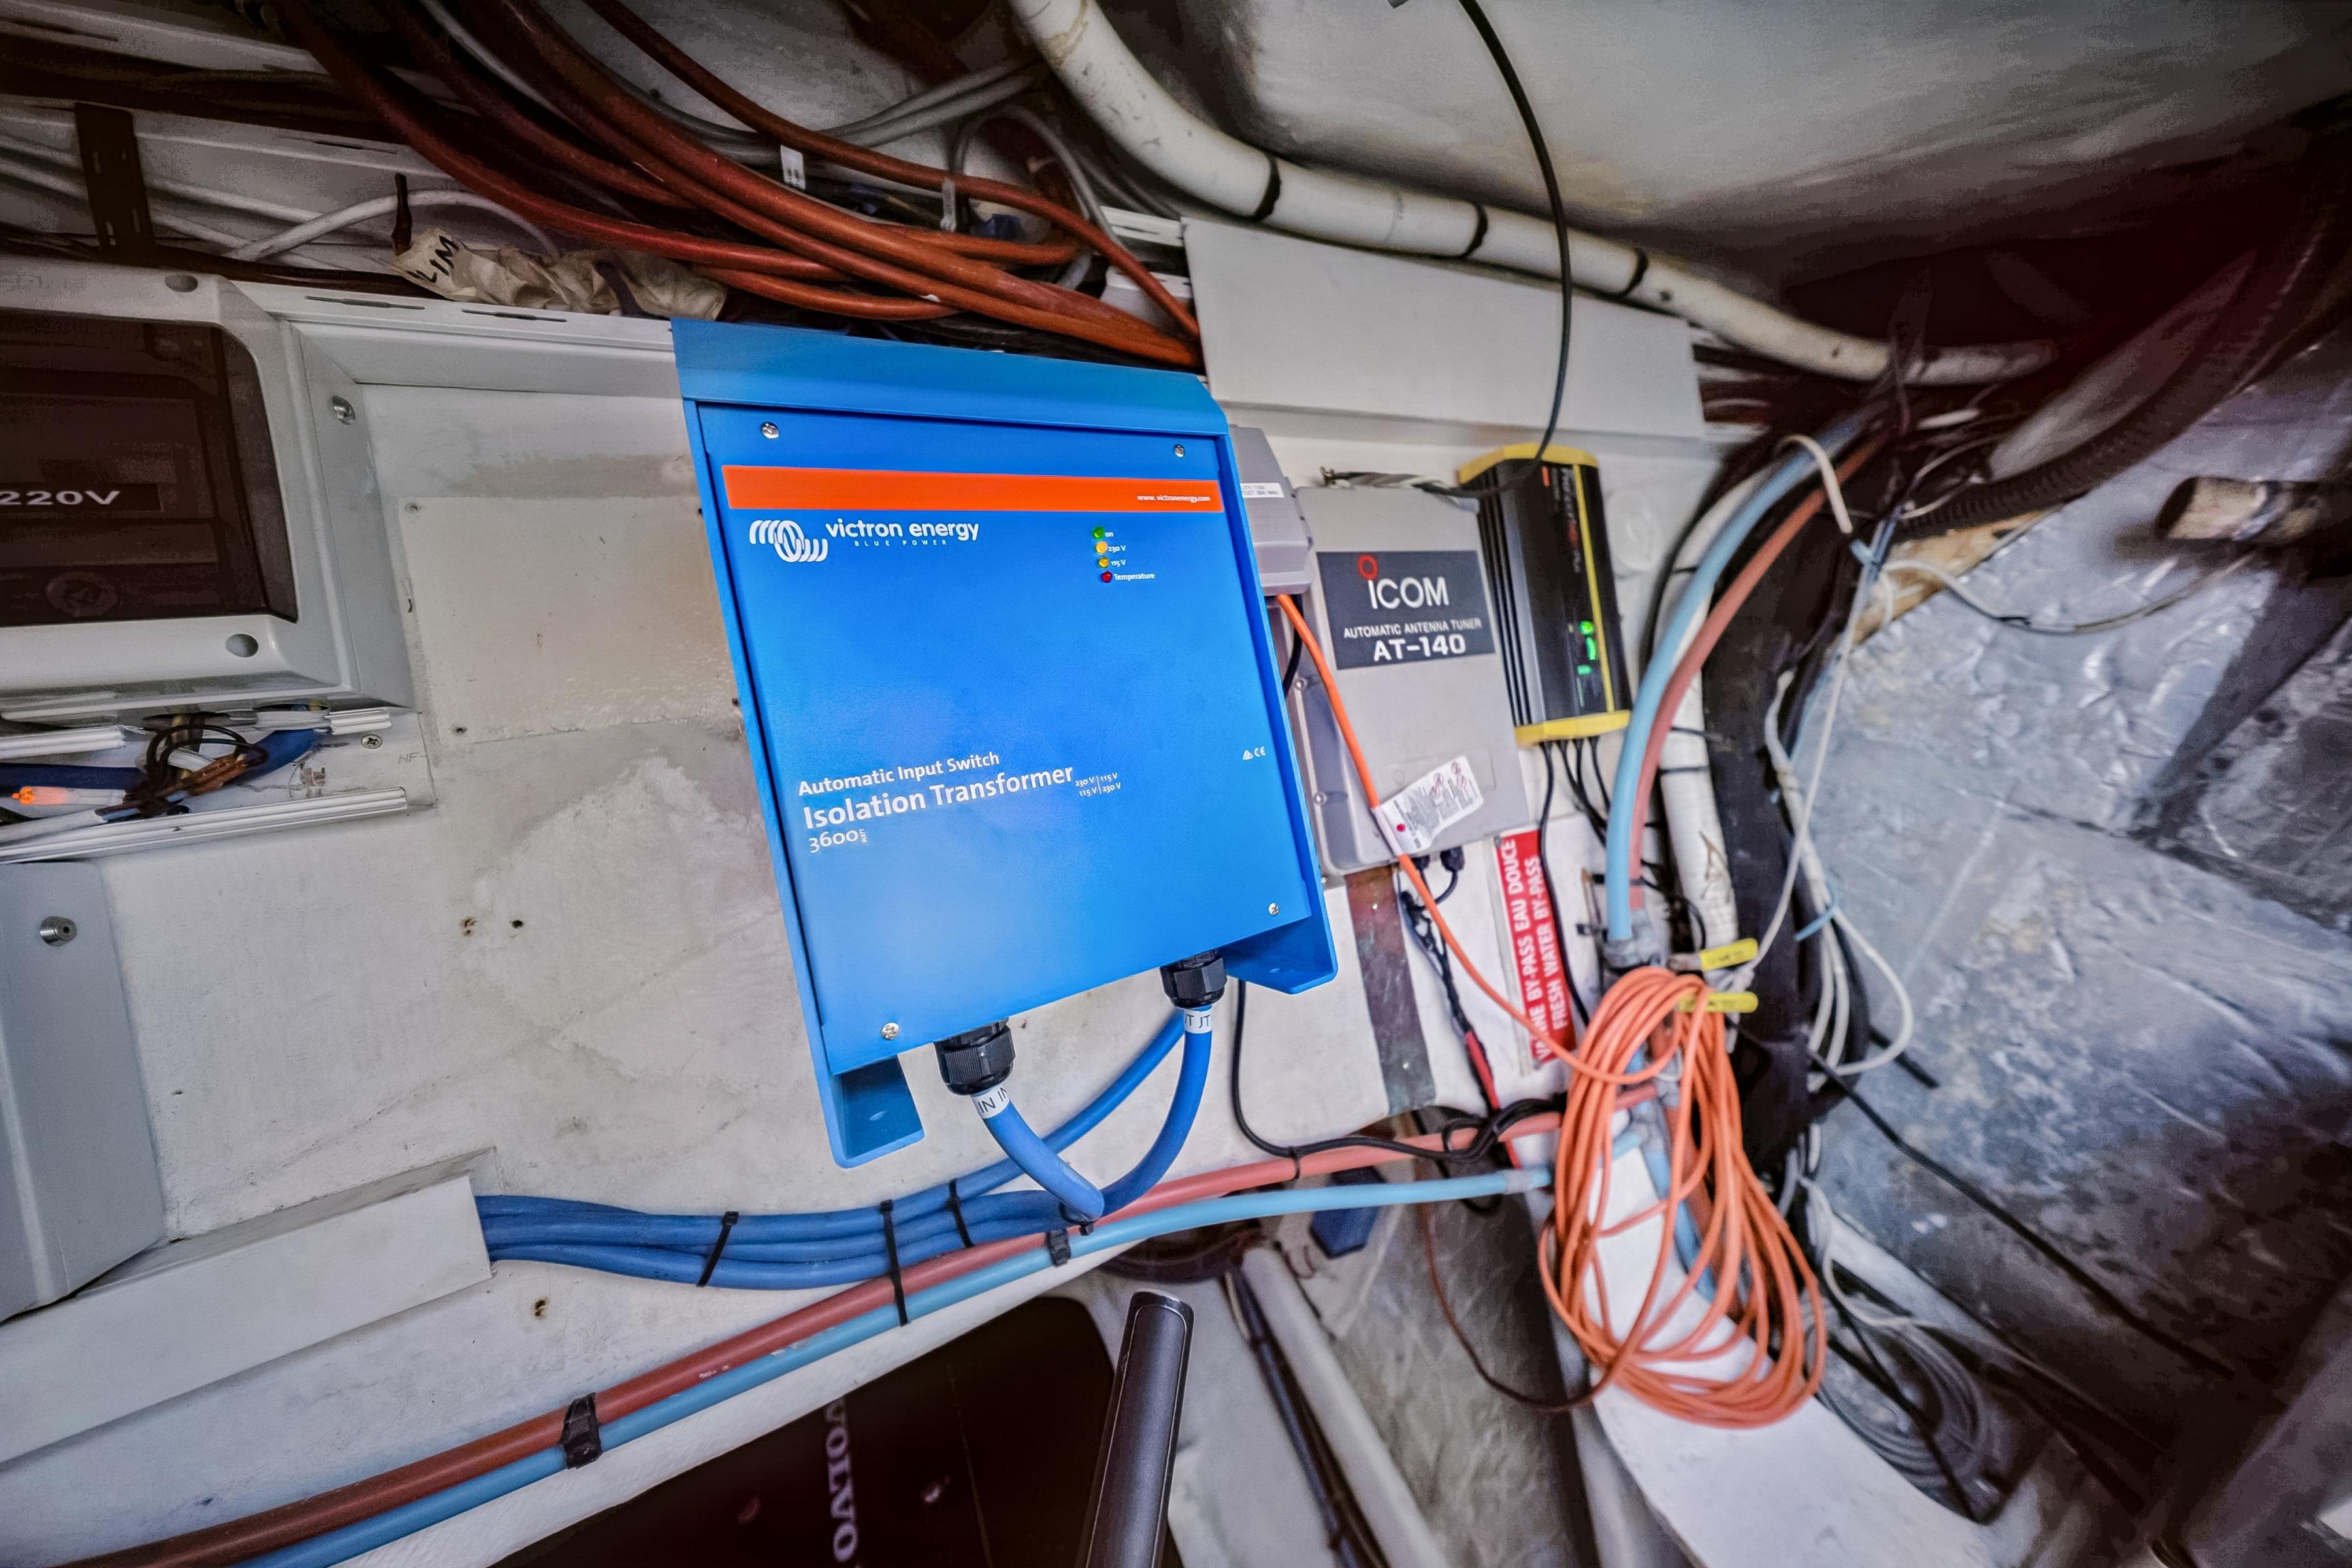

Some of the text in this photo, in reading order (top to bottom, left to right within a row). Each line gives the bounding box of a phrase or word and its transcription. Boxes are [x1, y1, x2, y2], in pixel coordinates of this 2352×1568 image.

[825, 518, 979, 541] victron energy
[1113, 573, 1155, 581] Temperature
[1344, 617, 1482, 639] AUTOMATIC ANTENNA TUNER
[1374, 634, 1466, 662] AT-140
[798, 752, 1000, 796] Automatic Input Switch
[1075, 779, 1088, 788] 230
[804, 767, 1073, 829] Isolation Transformer
[1102, 785, 1115, 793] 230
[808, 828, 868, 853] 3600 WATT
[1501, 839, 1524, 896] DOUCE
[1511, 899, 1531, 933] EAU
[1524, 855, 1569, 1030] FRESH WATER BY-PASS
[1518, 935, 1543, 1002] BY-PASS
[977, 1097, 996, 1113] IN
[826, 1397, 858, 1562] VOLVO
